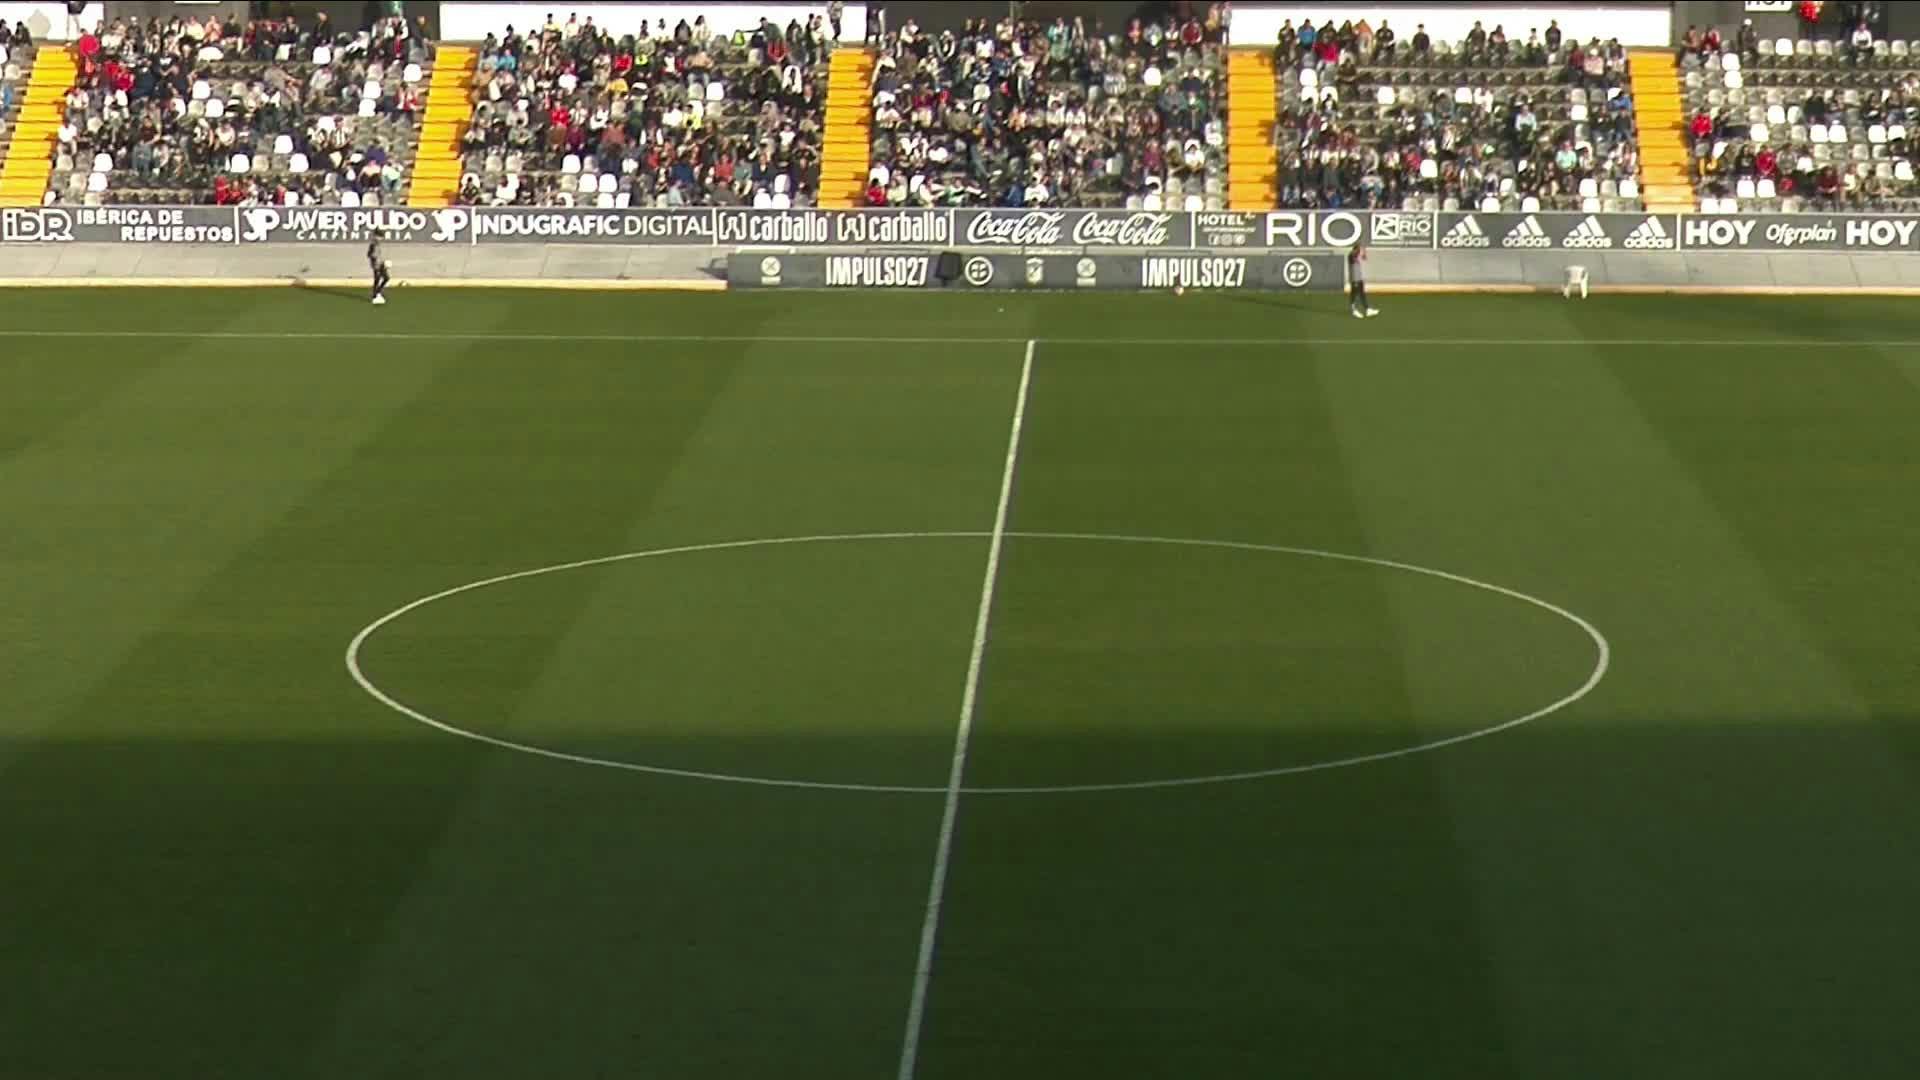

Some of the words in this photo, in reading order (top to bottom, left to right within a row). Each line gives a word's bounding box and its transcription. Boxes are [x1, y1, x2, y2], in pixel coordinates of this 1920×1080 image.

[77, 208, 154, 225] IBÉRICA
[158, 209, 184, 225] DE
[282, 209, 348, 231] JAVIER
[353, 210, 426, 231] PULIDO
[474, 214, 620, 236] INDUGRAFIC
[624, 215, 713, 236] DIGITAL
[750, 211, 829, 242] carballo
[868, 211, 948, 242] carballo
[966, 211, 1065, 244] Coca-Cola
[1198, 214, 1244, 226] HOTEL
[1399, 220, 1431, 232] RIO
[121, 226, 234, 241] REPUESTOS
[296, 231, 412, 240] CARPINTRIA
[1072, 211, 1172, 245] Coca-Cola
[1265, 212, 1362, 247] RIO
[1684, 219, 1757, 246] HOY
[1846, 219, 1918, 246] HOY
[1440, 235, 1490, 248] adidas
[1502, 235, 1551, 248] adidas
[1562, 235, 1612, 249] adidas
[1623, 236, 1674, 249] adidas
[824, 256, 929, 286] IMPULSO27
[1141, 257, 1246, 287] IMPULSO27
